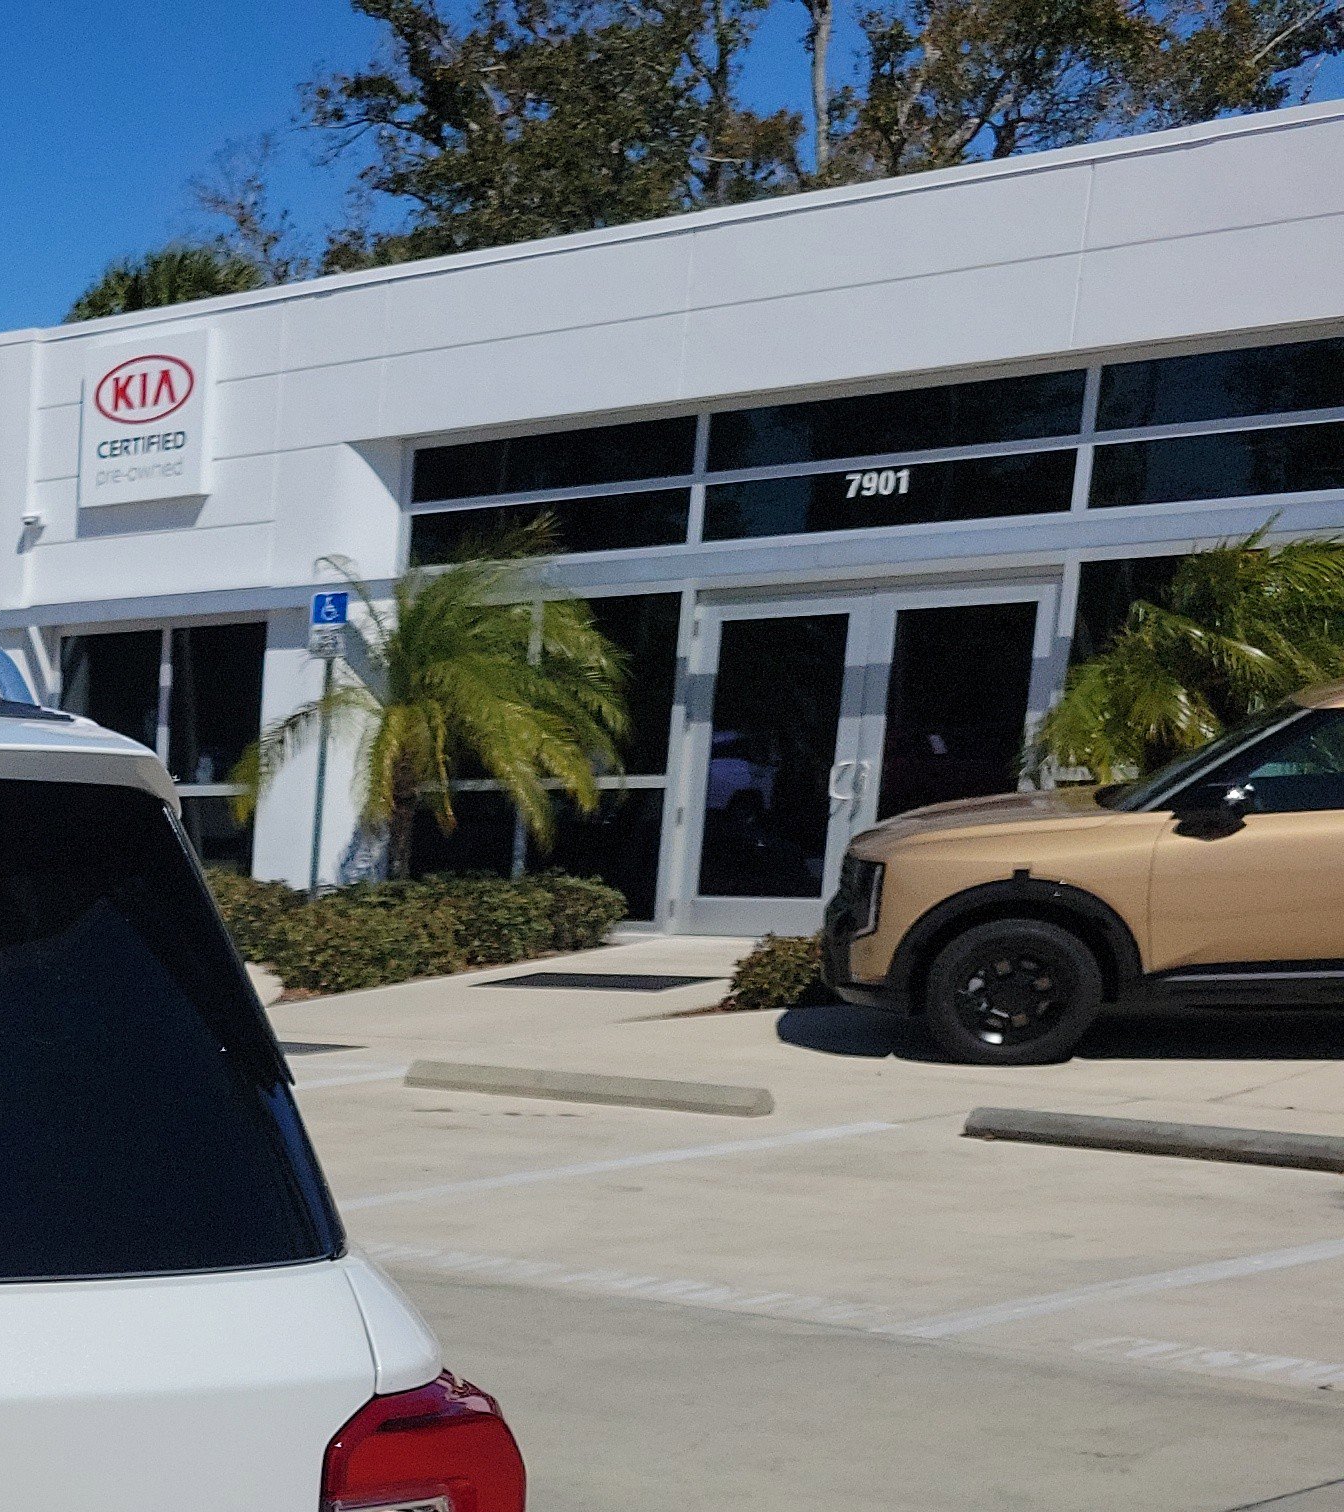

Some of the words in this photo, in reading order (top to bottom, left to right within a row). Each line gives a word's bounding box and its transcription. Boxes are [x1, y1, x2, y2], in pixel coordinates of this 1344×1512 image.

[112, 368, 176, 412] KIA
[96, 430, 186, 459] CERTIFIED
[96, 458, 183, 486] pre-owned
[844, 468, 911, 499] 7901
